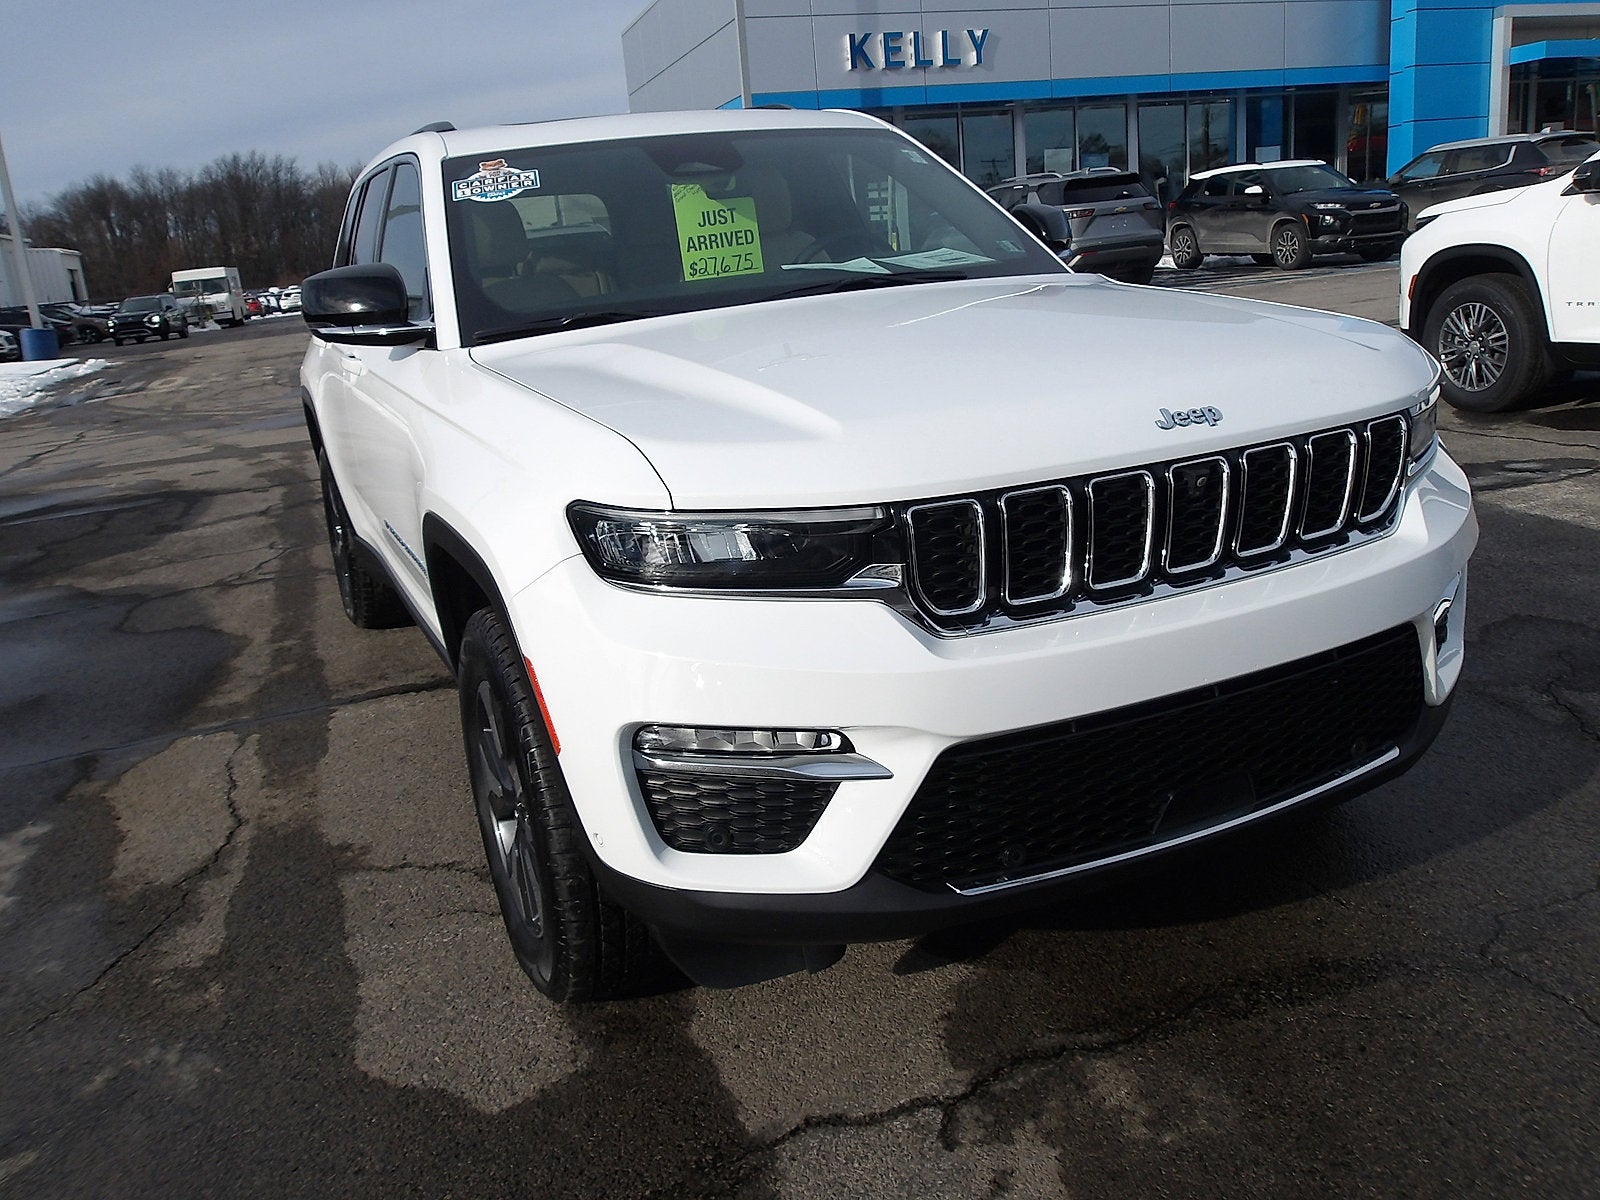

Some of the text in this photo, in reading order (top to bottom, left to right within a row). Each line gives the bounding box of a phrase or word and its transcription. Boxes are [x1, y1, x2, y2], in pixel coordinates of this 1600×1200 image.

[846, 29, 989, 71] KELLY
[458, 174, 532, 189] CARFAX
[697, 207, 736, 228] JUST
[686, 229, 755, 253] ARRIVED
[688, 252, 755, 278] $27,675
[1155, 405, 1223, 430] Jeep
